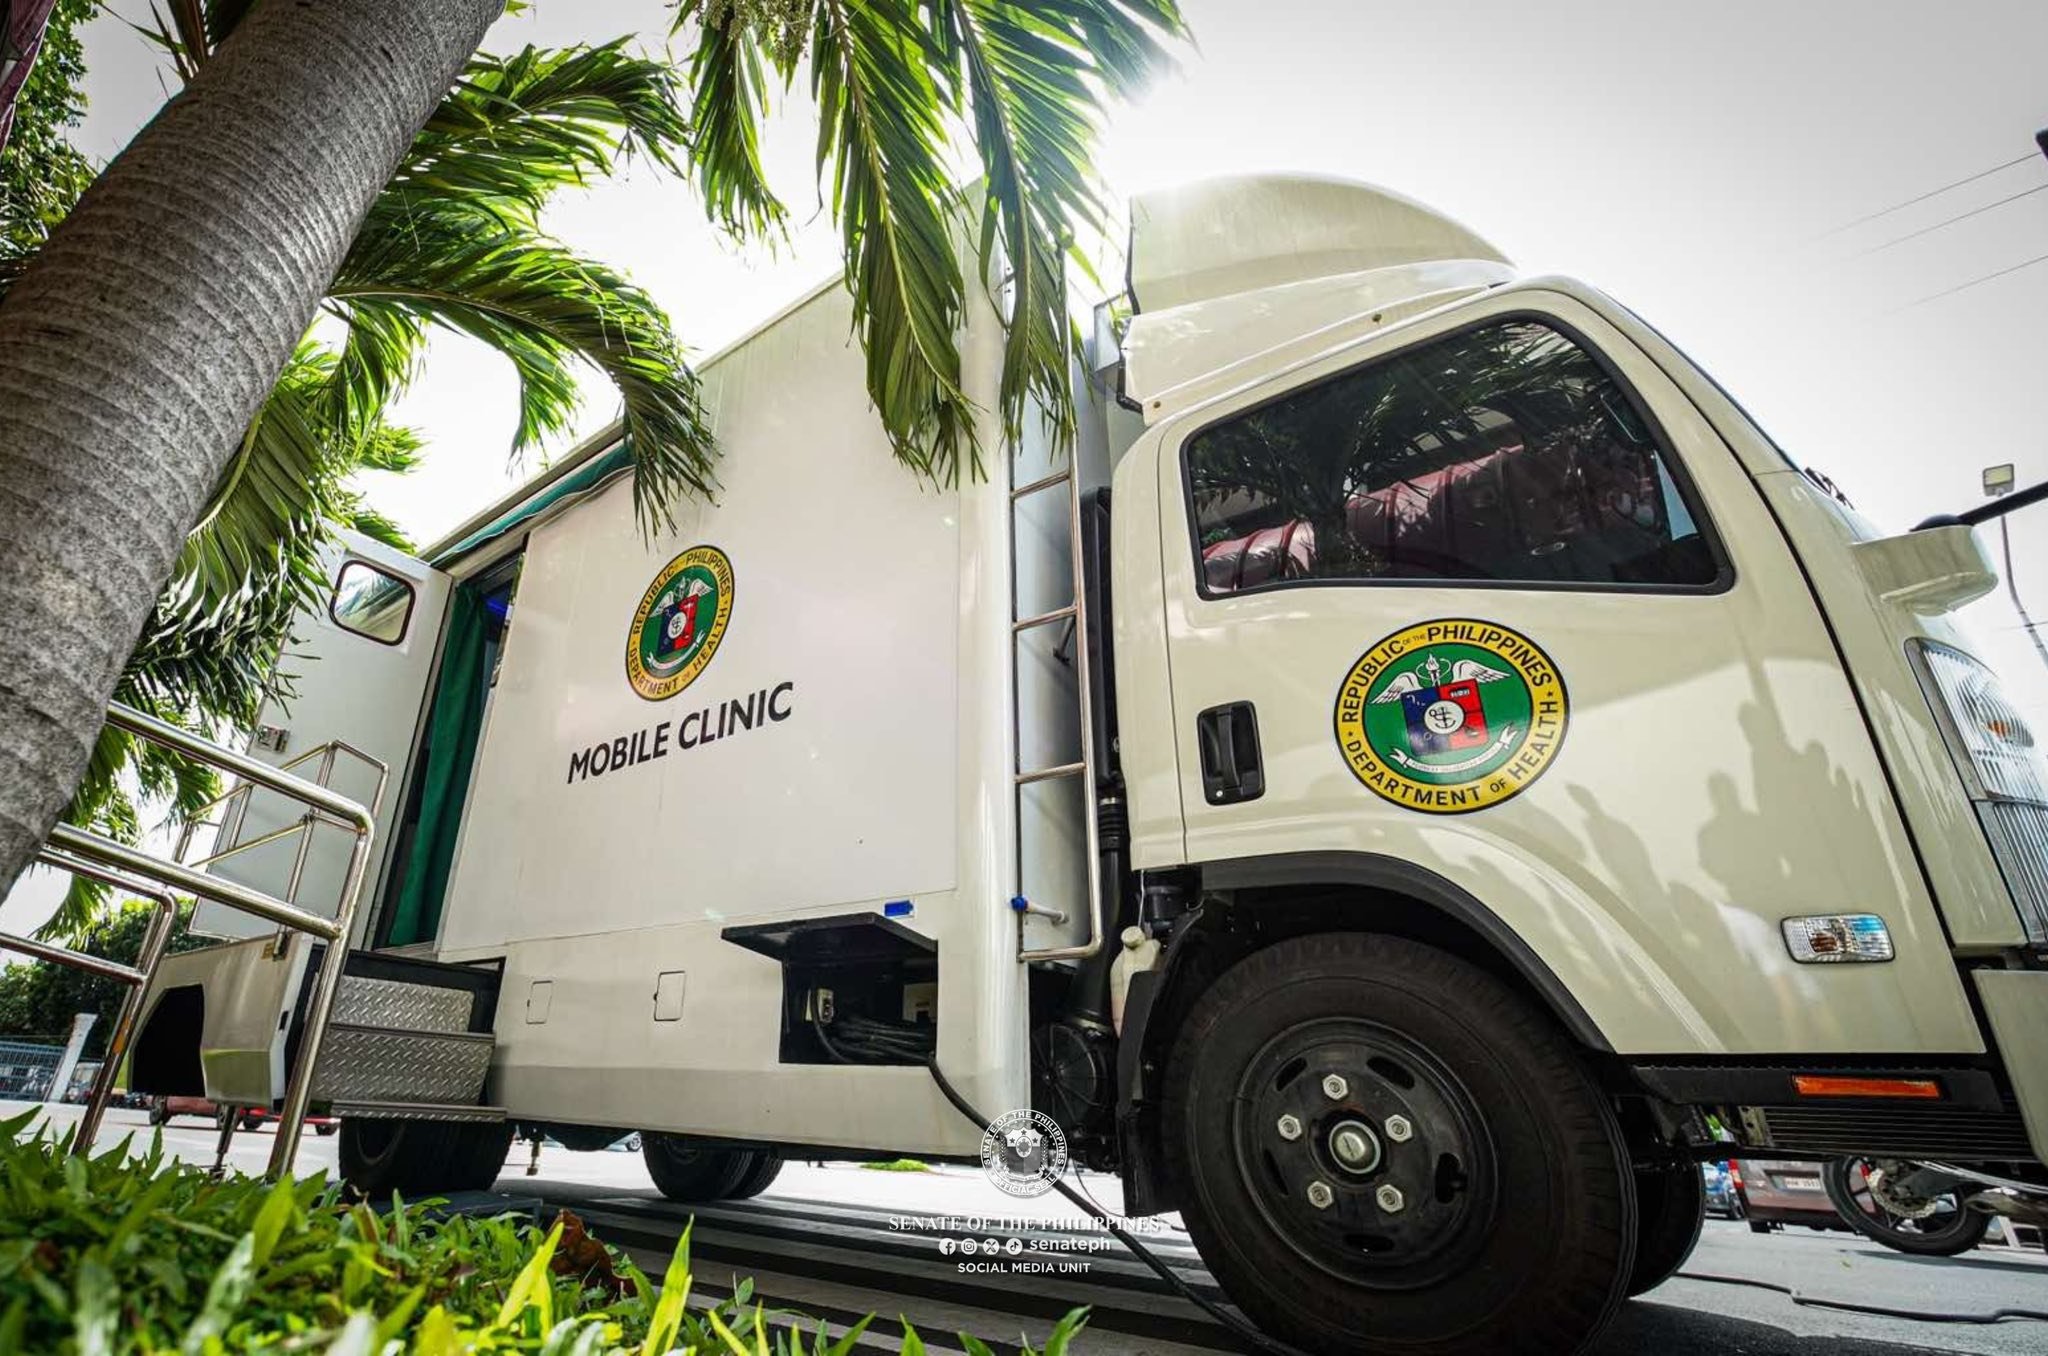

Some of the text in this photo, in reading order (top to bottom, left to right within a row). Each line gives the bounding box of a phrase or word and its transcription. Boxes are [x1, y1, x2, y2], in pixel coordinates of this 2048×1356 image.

[633, 551, 731, 635] REPUBLIC PHILIPPINES
[629, 647, 679, 695] DEPARTMENT
[693, 607, 727, 671] HEALTH
[1341, 640, 1405, 723] REPUBLIC
[1427, 624, 1553, 688] PHILIPPINES
[567, 682, 794, 784] MOBILE CLINIC
[1346, 700, 1558, 806] DEPARTMENT OF HEALTH
